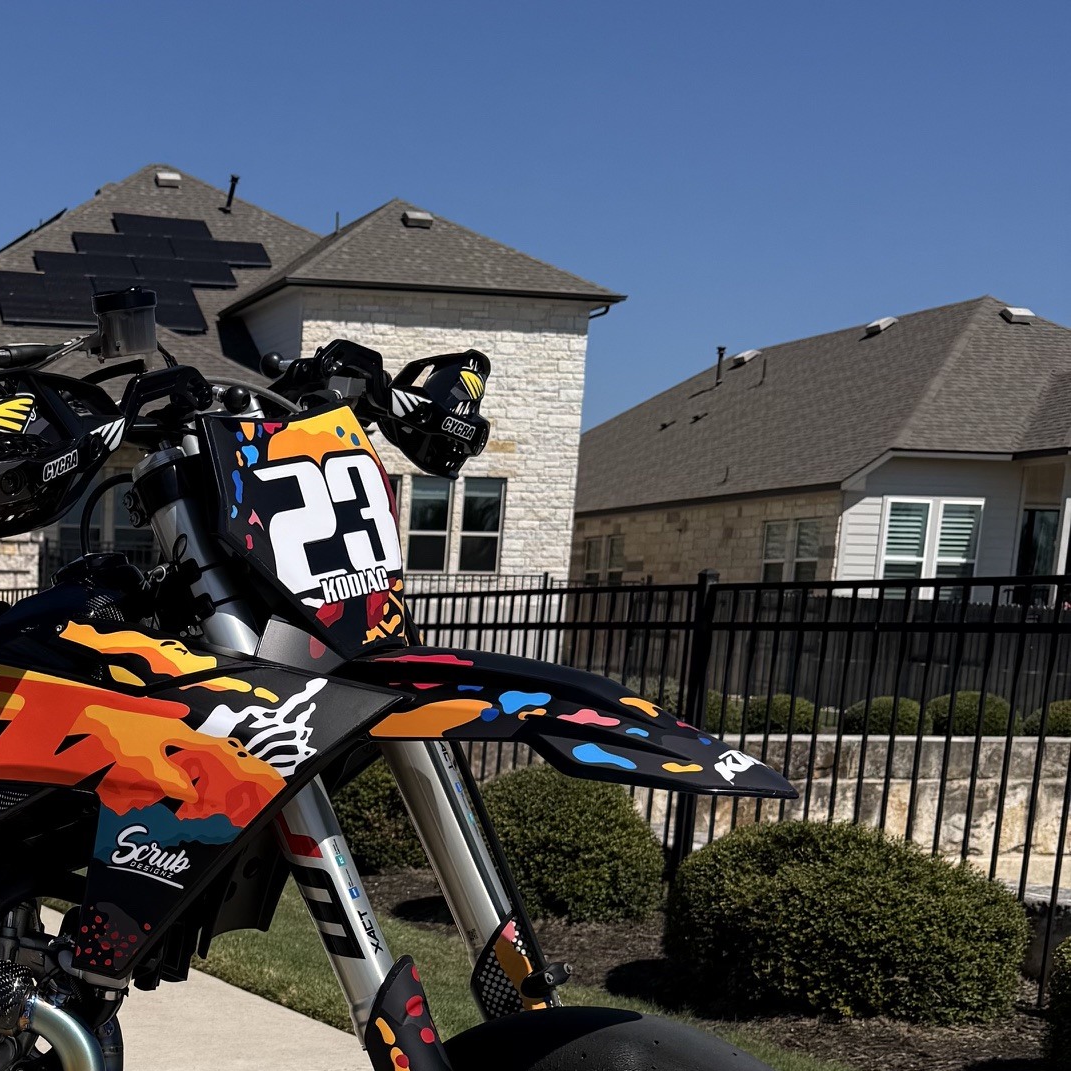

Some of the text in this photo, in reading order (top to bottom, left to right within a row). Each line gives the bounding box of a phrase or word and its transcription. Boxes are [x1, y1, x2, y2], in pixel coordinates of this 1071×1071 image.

[441, 416, 476, 440] CYCRA
[43, 449, 78, 482] CYCRA
[253, 454, 402, 594] 23
[321, 566, 389, 604] KODIAC
[111, 825, 191, 874] Scrub
[129, 861, 174, 879] DESIGNZ
[357, 910, 384, 955] XACT
